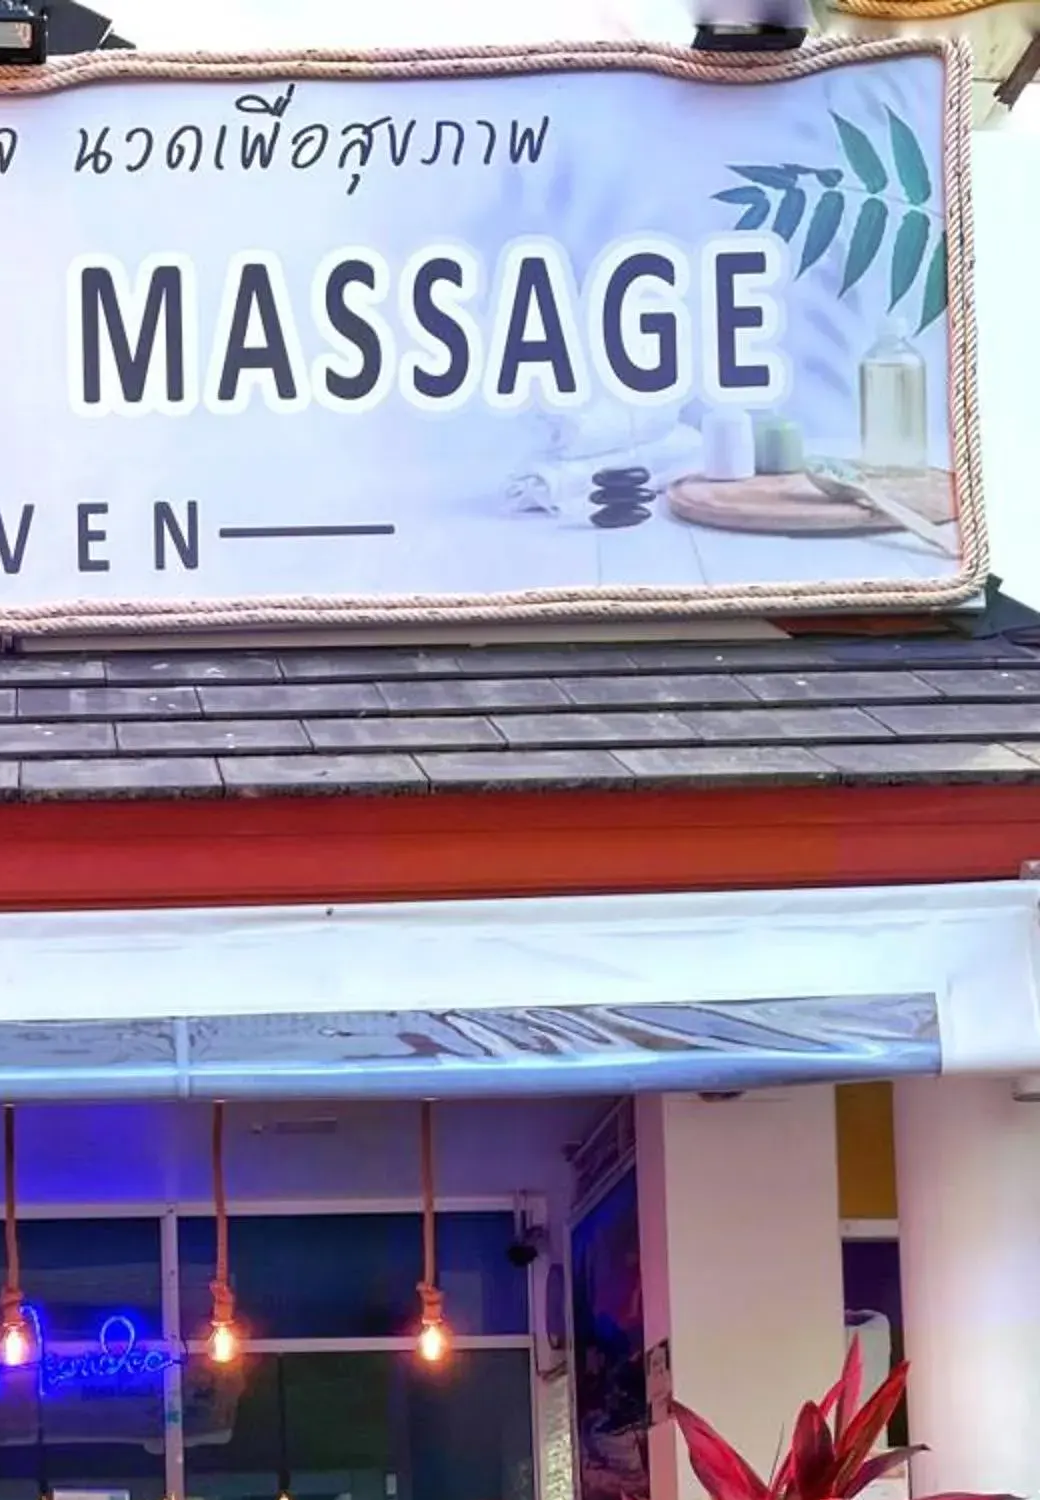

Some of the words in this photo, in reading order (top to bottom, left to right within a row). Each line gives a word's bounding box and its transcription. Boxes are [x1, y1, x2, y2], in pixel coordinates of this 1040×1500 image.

[74, 84, 550, 196] นวดเพื่อสุขภาพ
[81, 250, 772, 405] MASSAGE
